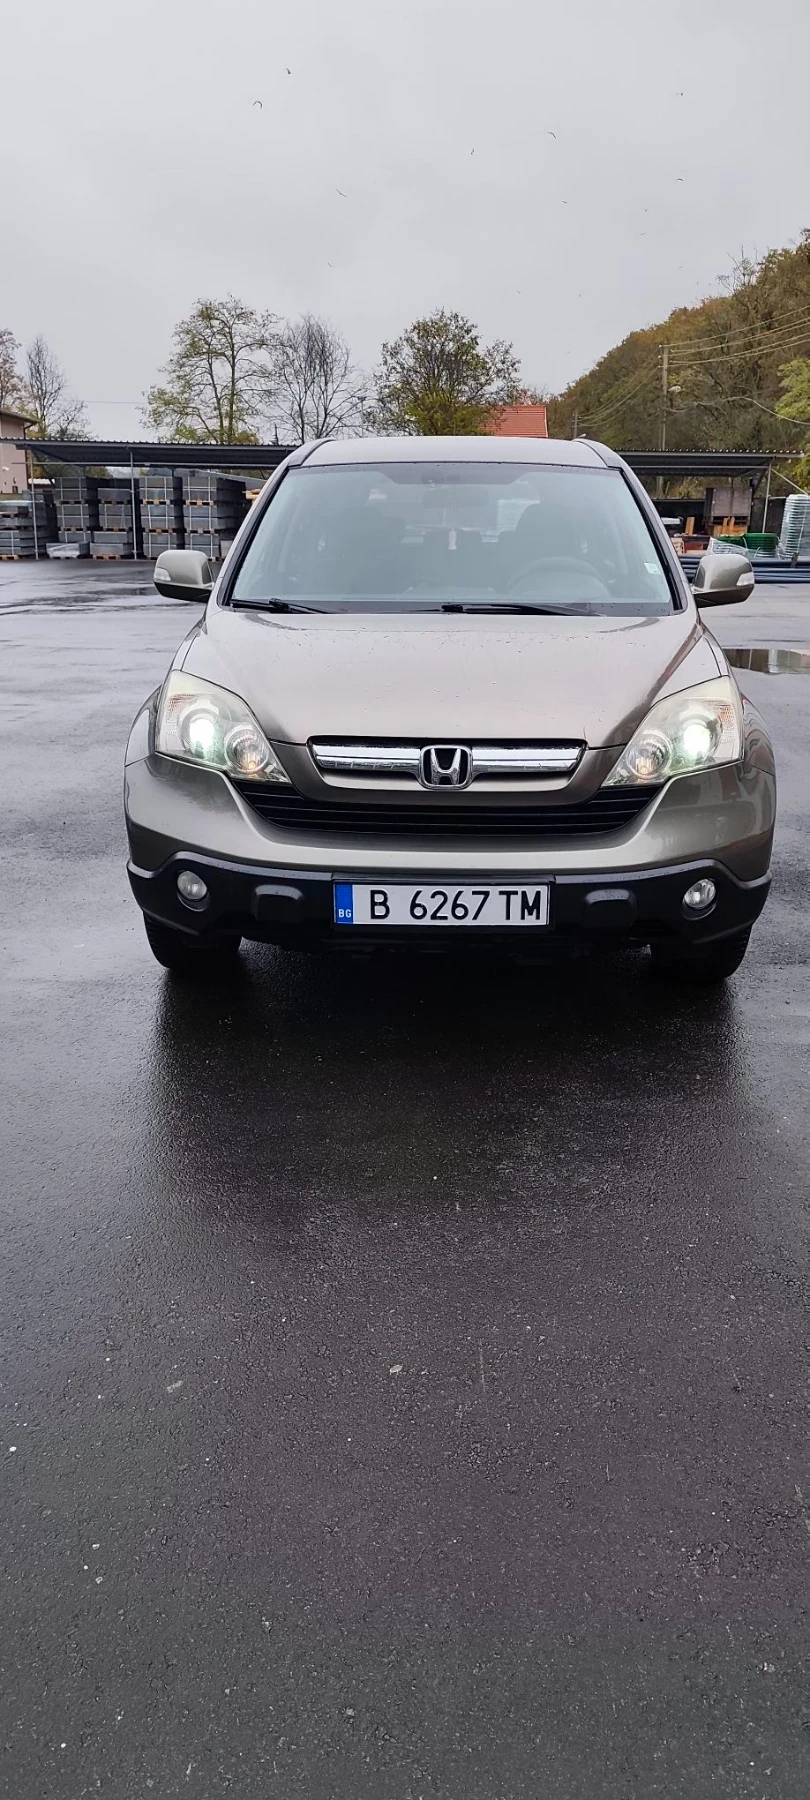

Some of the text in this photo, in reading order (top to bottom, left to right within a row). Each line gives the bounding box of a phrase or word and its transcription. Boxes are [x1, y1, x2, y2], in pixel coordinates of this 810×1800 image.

[338, 908, 352, 918] BG
[370, 889, 542, 920] B 6267 TM
